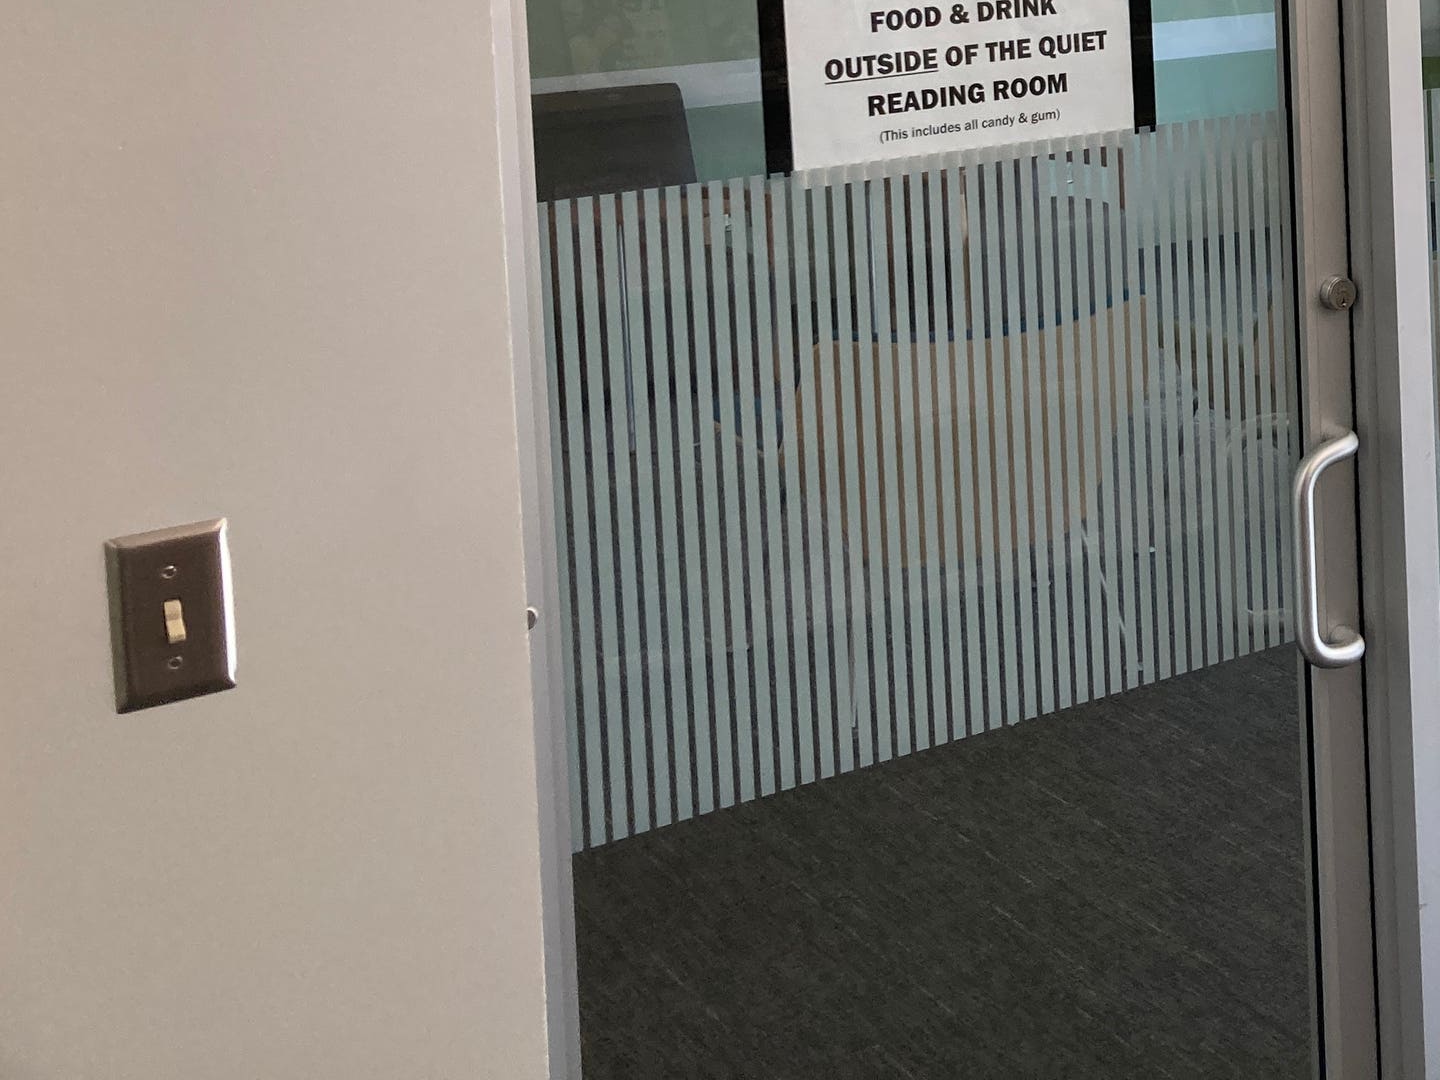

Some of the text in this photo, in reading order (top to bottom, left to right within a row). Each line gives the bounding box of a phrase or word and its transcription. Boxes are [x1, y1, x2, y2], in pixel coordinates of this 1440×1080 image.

[871, 7, 941, 33] FOOD
[950, 4, 970, 24] &
[825, 30, 1107, 81] OUTSIDE OF THE QUIET
[868, 73, 1068, 116] READING ROOM
[879, 108, 1061, 144] (This includes all candy & gum)
